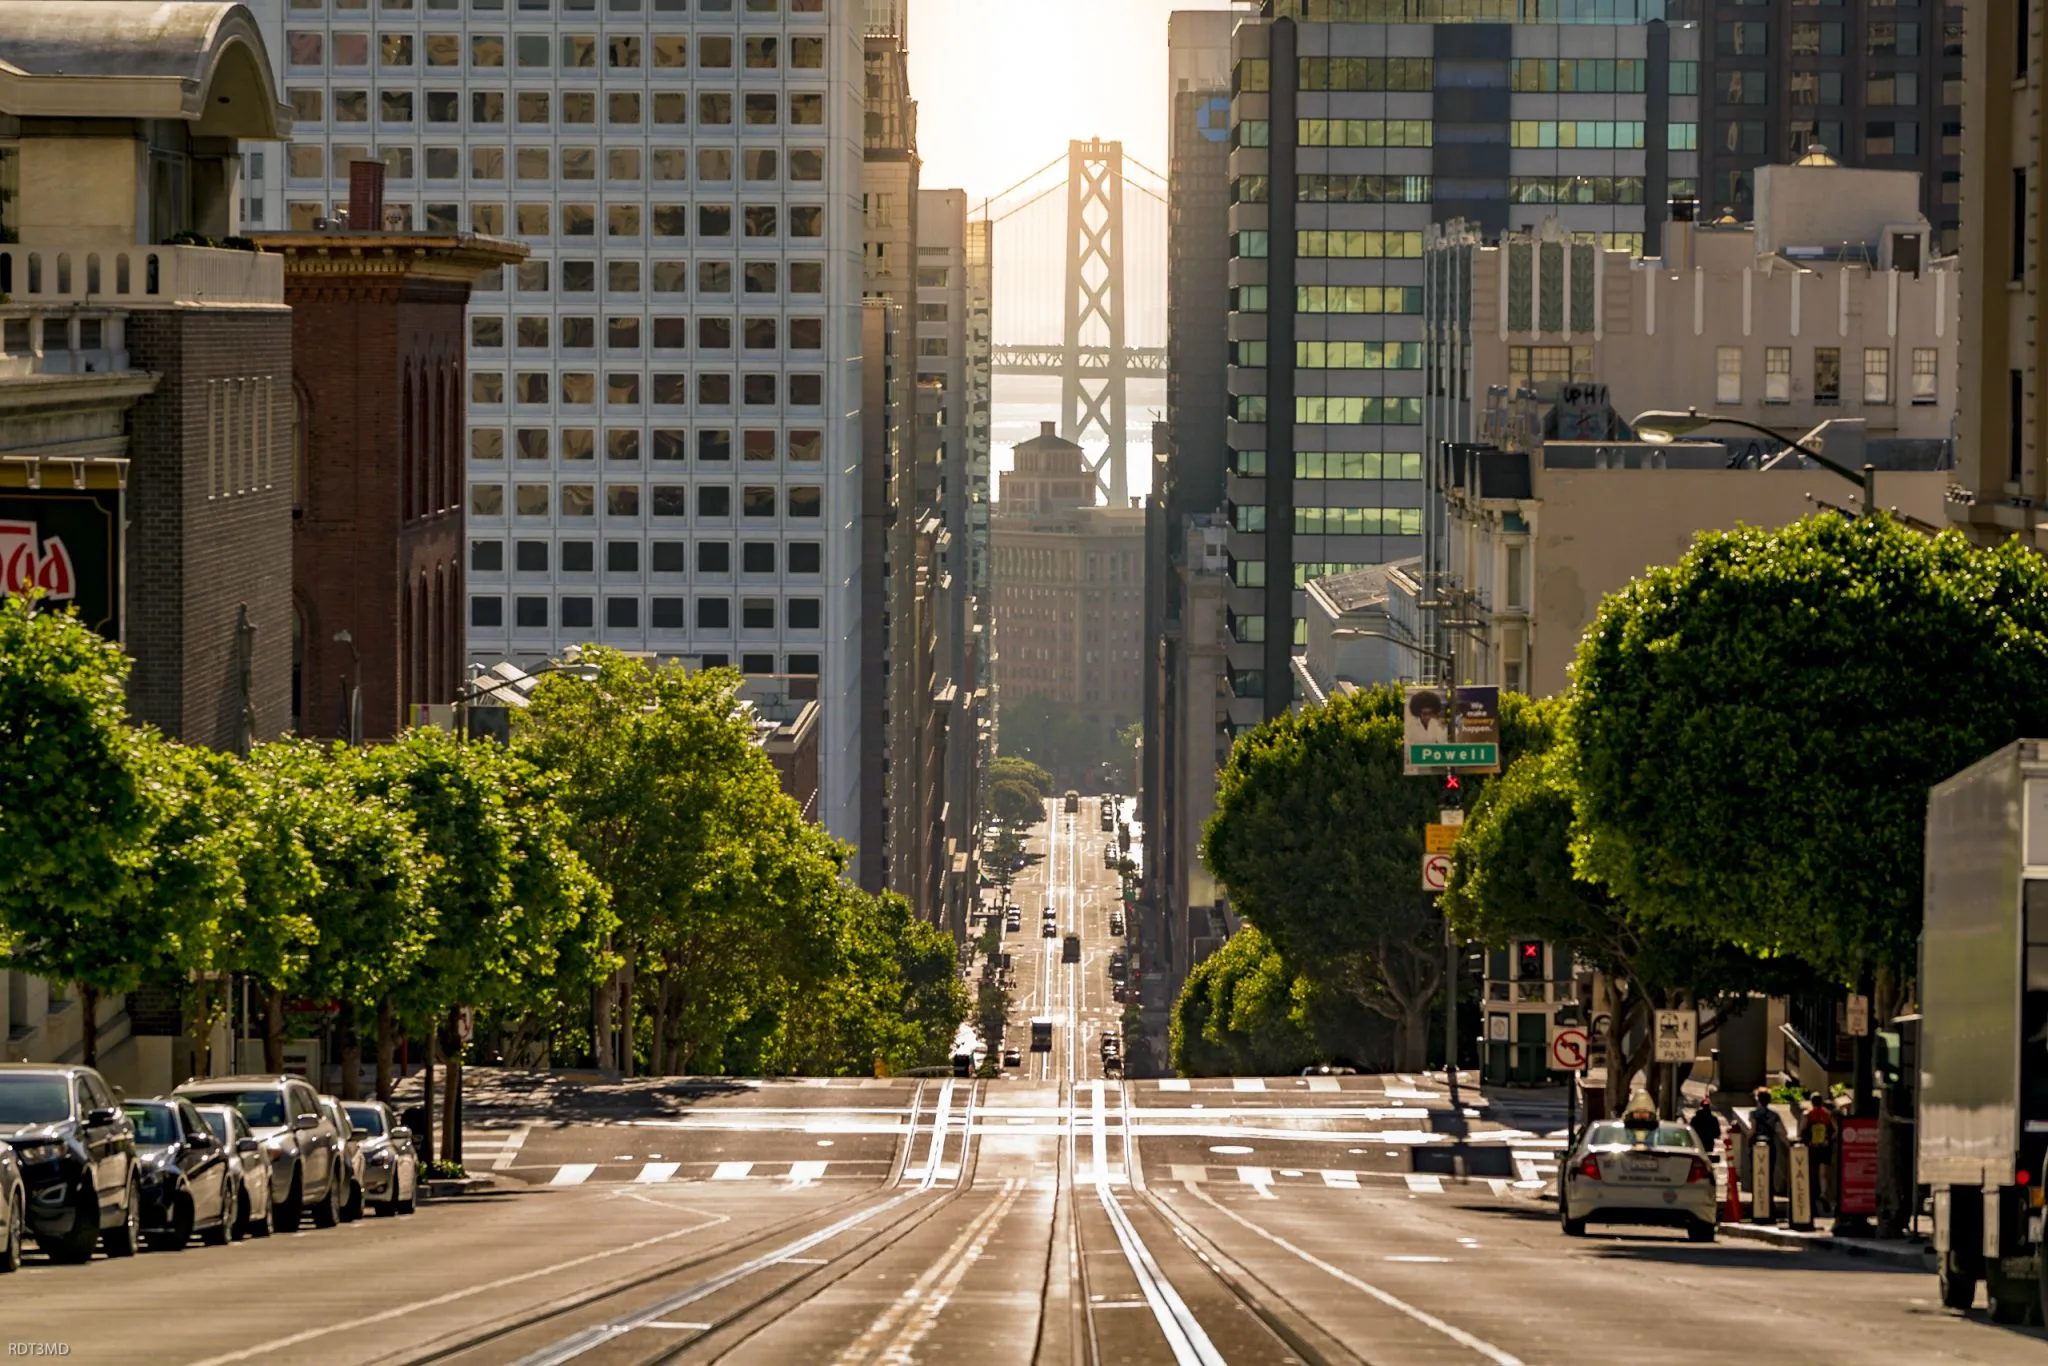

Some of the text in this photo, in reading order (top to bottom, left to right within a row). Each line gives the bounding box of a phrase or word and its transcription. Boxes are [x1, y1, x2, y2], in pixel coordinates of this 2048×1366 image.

[1421, 748, 1485, 760] Powell
[1658, 1040, 1692, 1049] DO NOT
[1664, 1050, 1687, 1059] PASS
[1757, 1153, 1766, 1211] VALET
[1794, 1155, 1805, 1217] VALET
